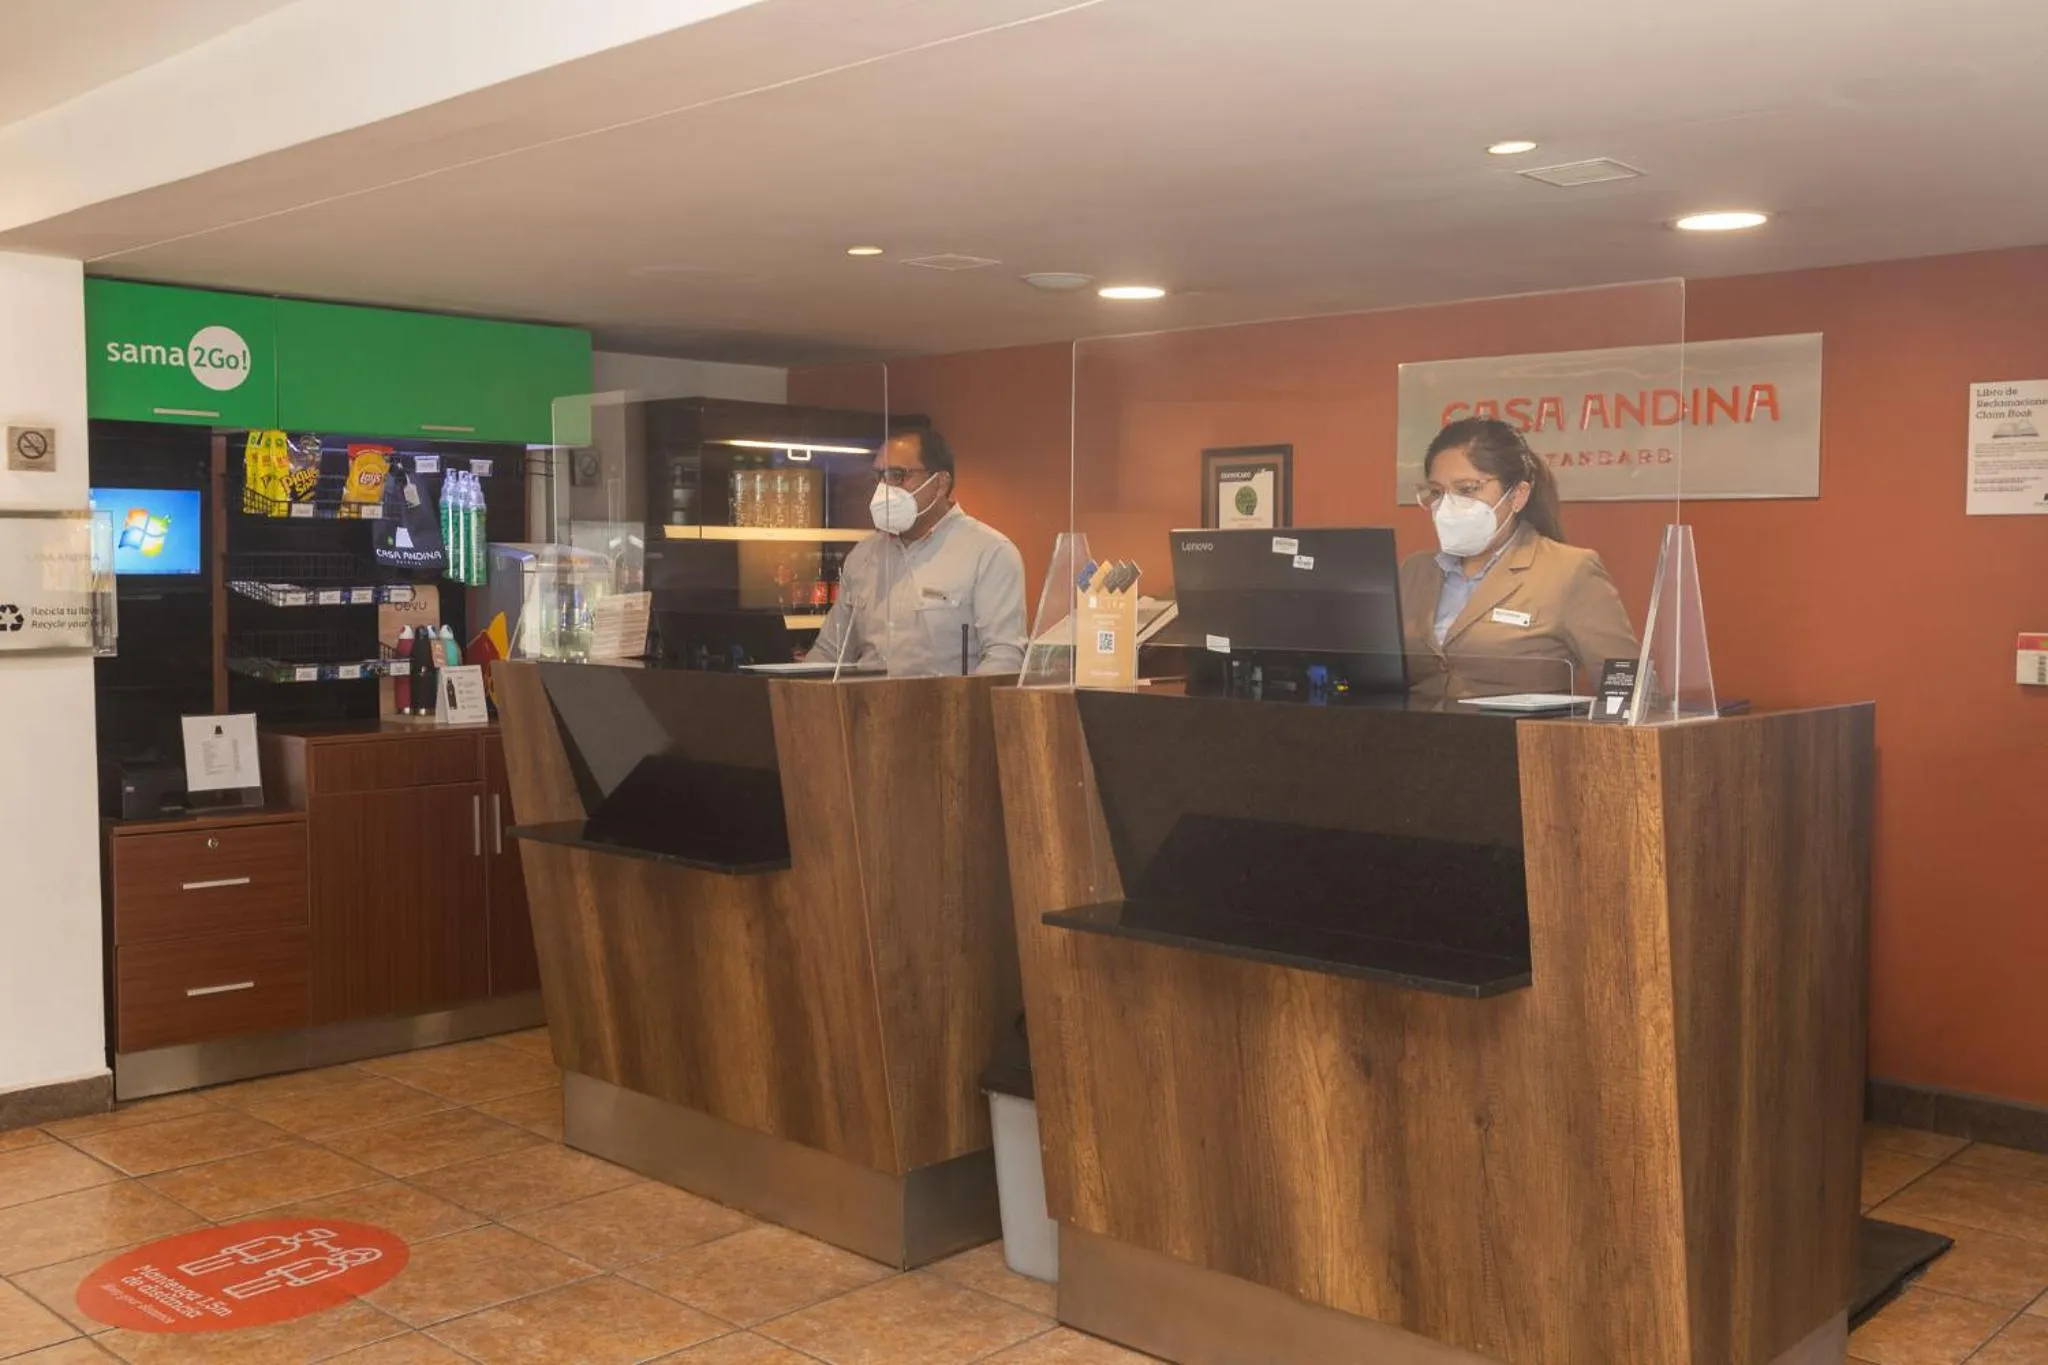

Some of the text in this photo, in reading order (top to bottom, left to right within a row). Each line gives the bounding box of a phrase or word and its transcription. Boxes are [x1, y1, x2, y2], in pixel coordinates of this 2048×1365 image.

[106, 341, 247, 370] sama 2Go!
[1976, 386, 2019, 397] Libro de
[1440, 383, 1781, 433] CASA ANDINA
[1545, 447, 1673, 469] TANDARD
[376, 548, 442, 561] CASA ANDINA
[1181, 541, 1215, 551] Lenovo
